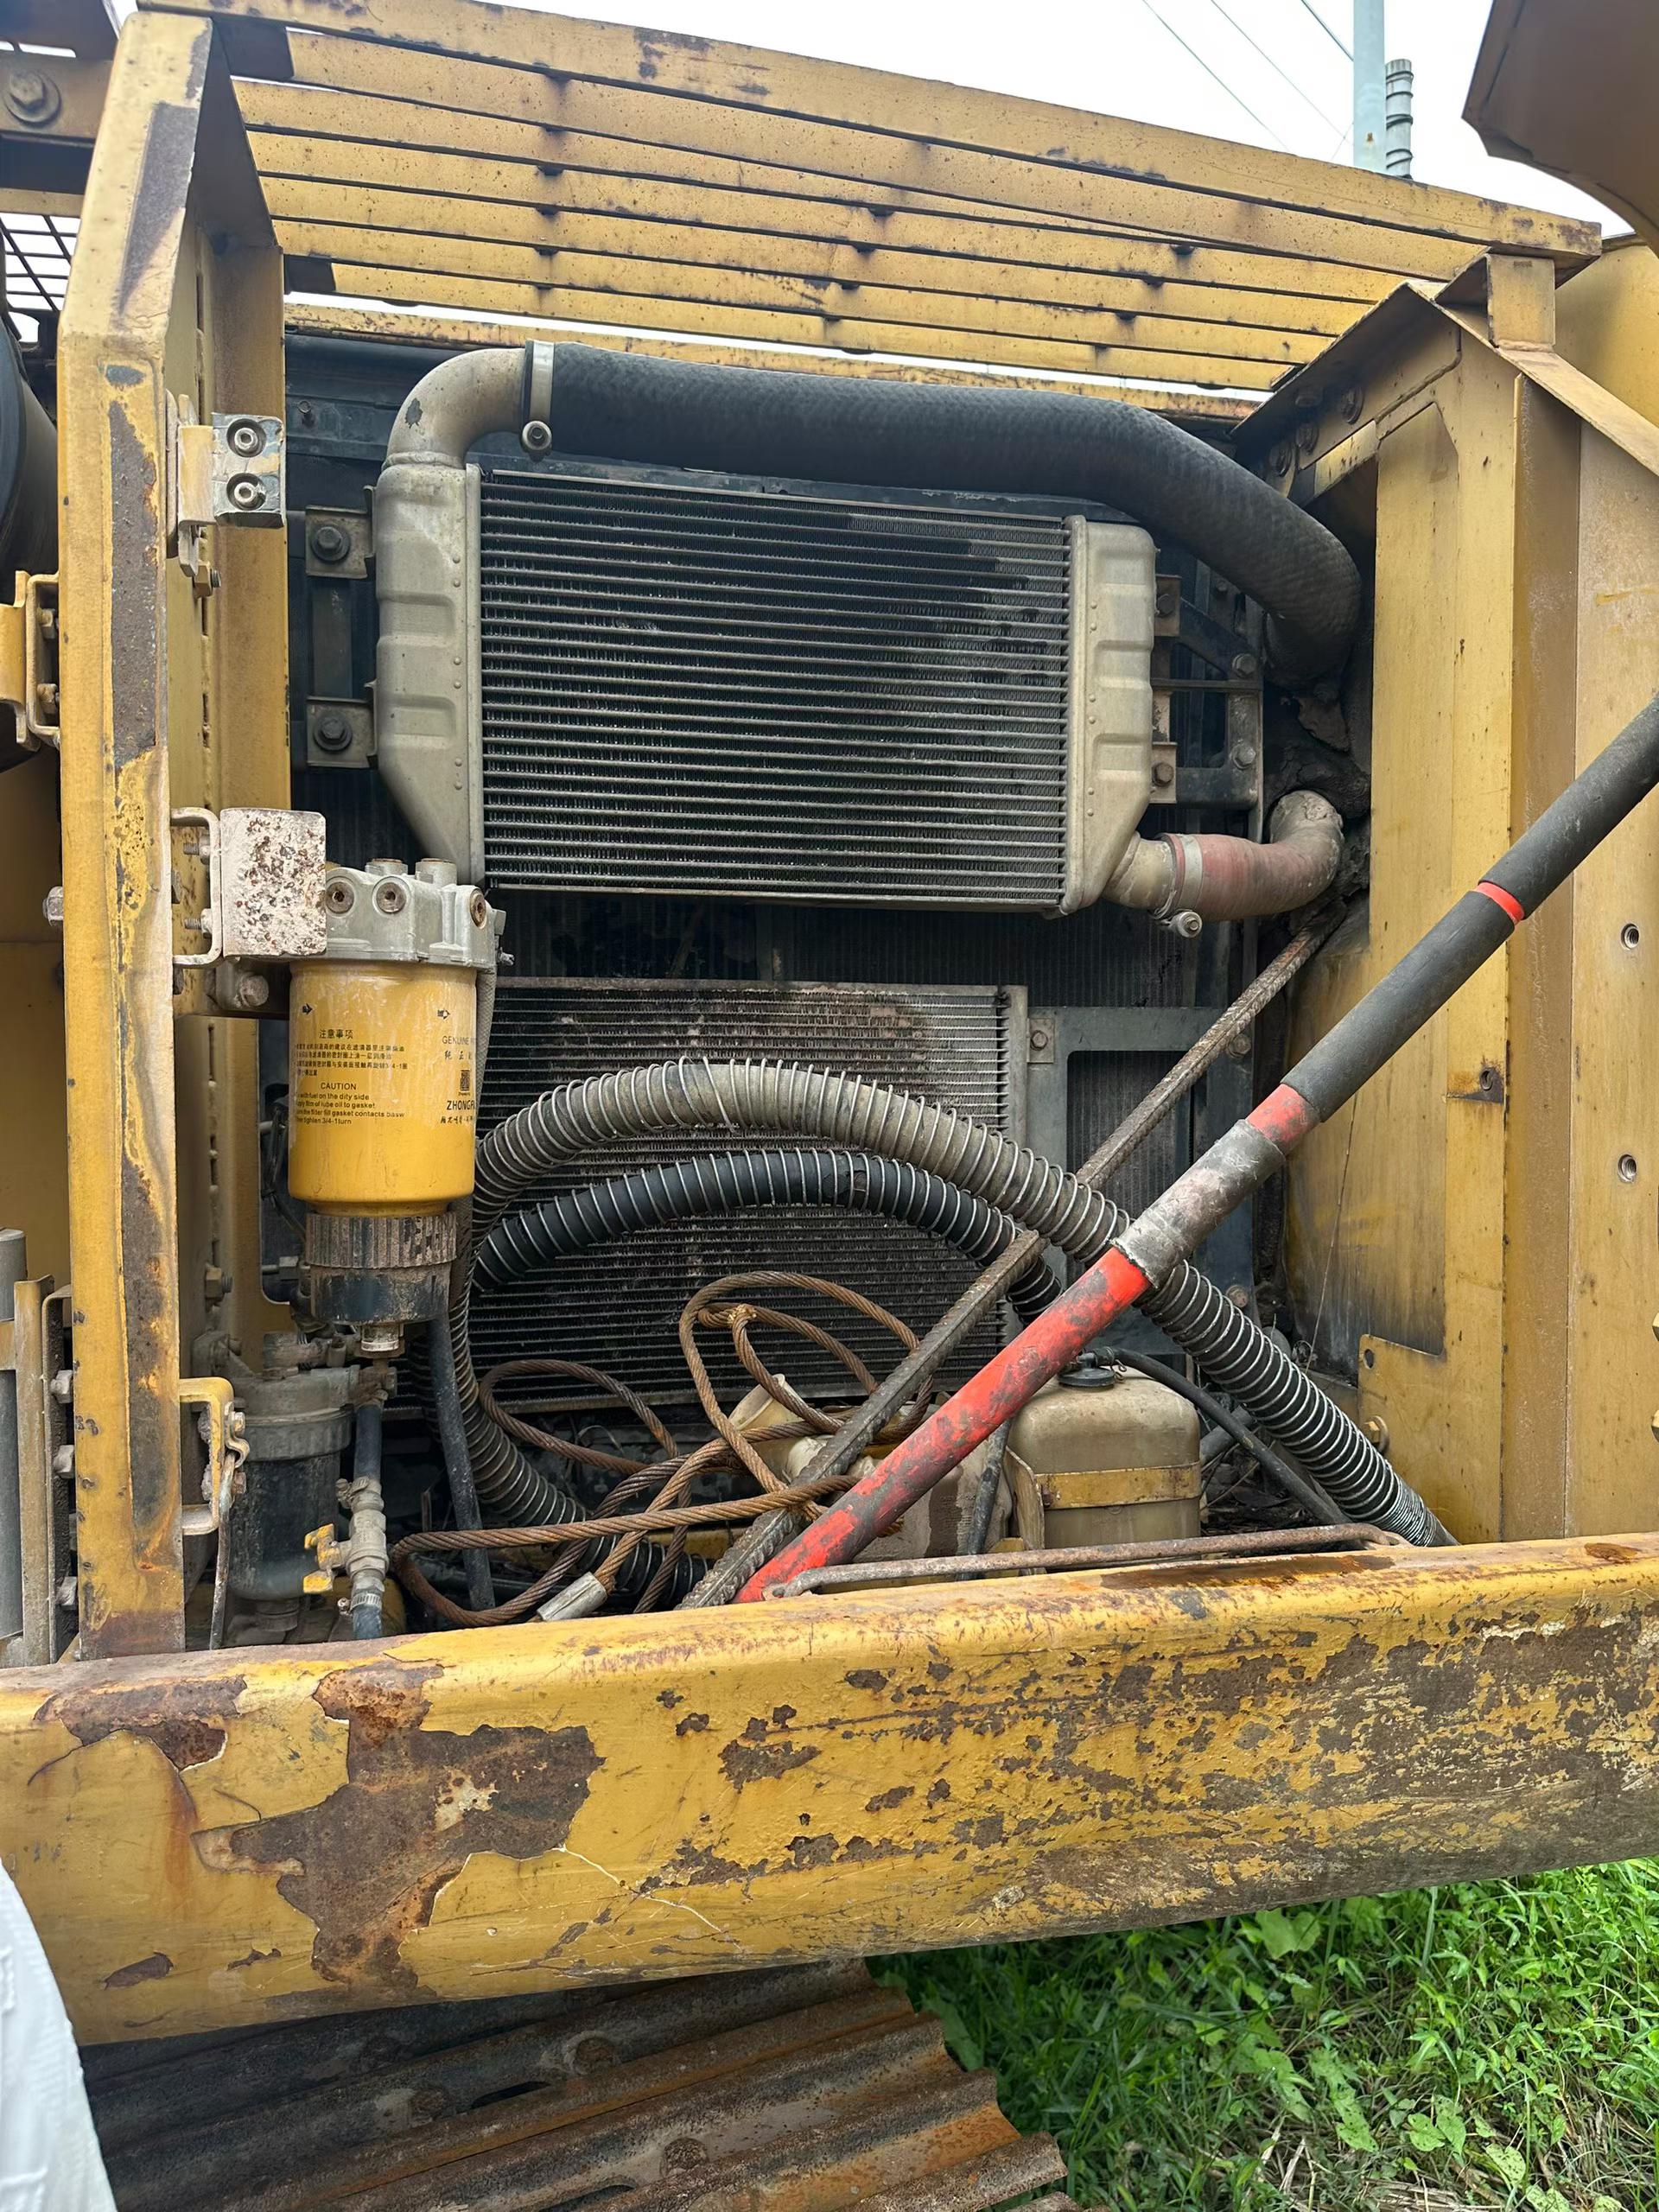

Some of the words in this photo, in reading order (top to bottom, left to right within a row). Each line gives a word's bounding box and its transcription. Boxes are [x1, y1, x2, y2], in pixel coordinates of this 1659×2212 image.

[319, 1029, 353, 1039] 注意事项
[321, 1082, 357, 1090] CAUTION
